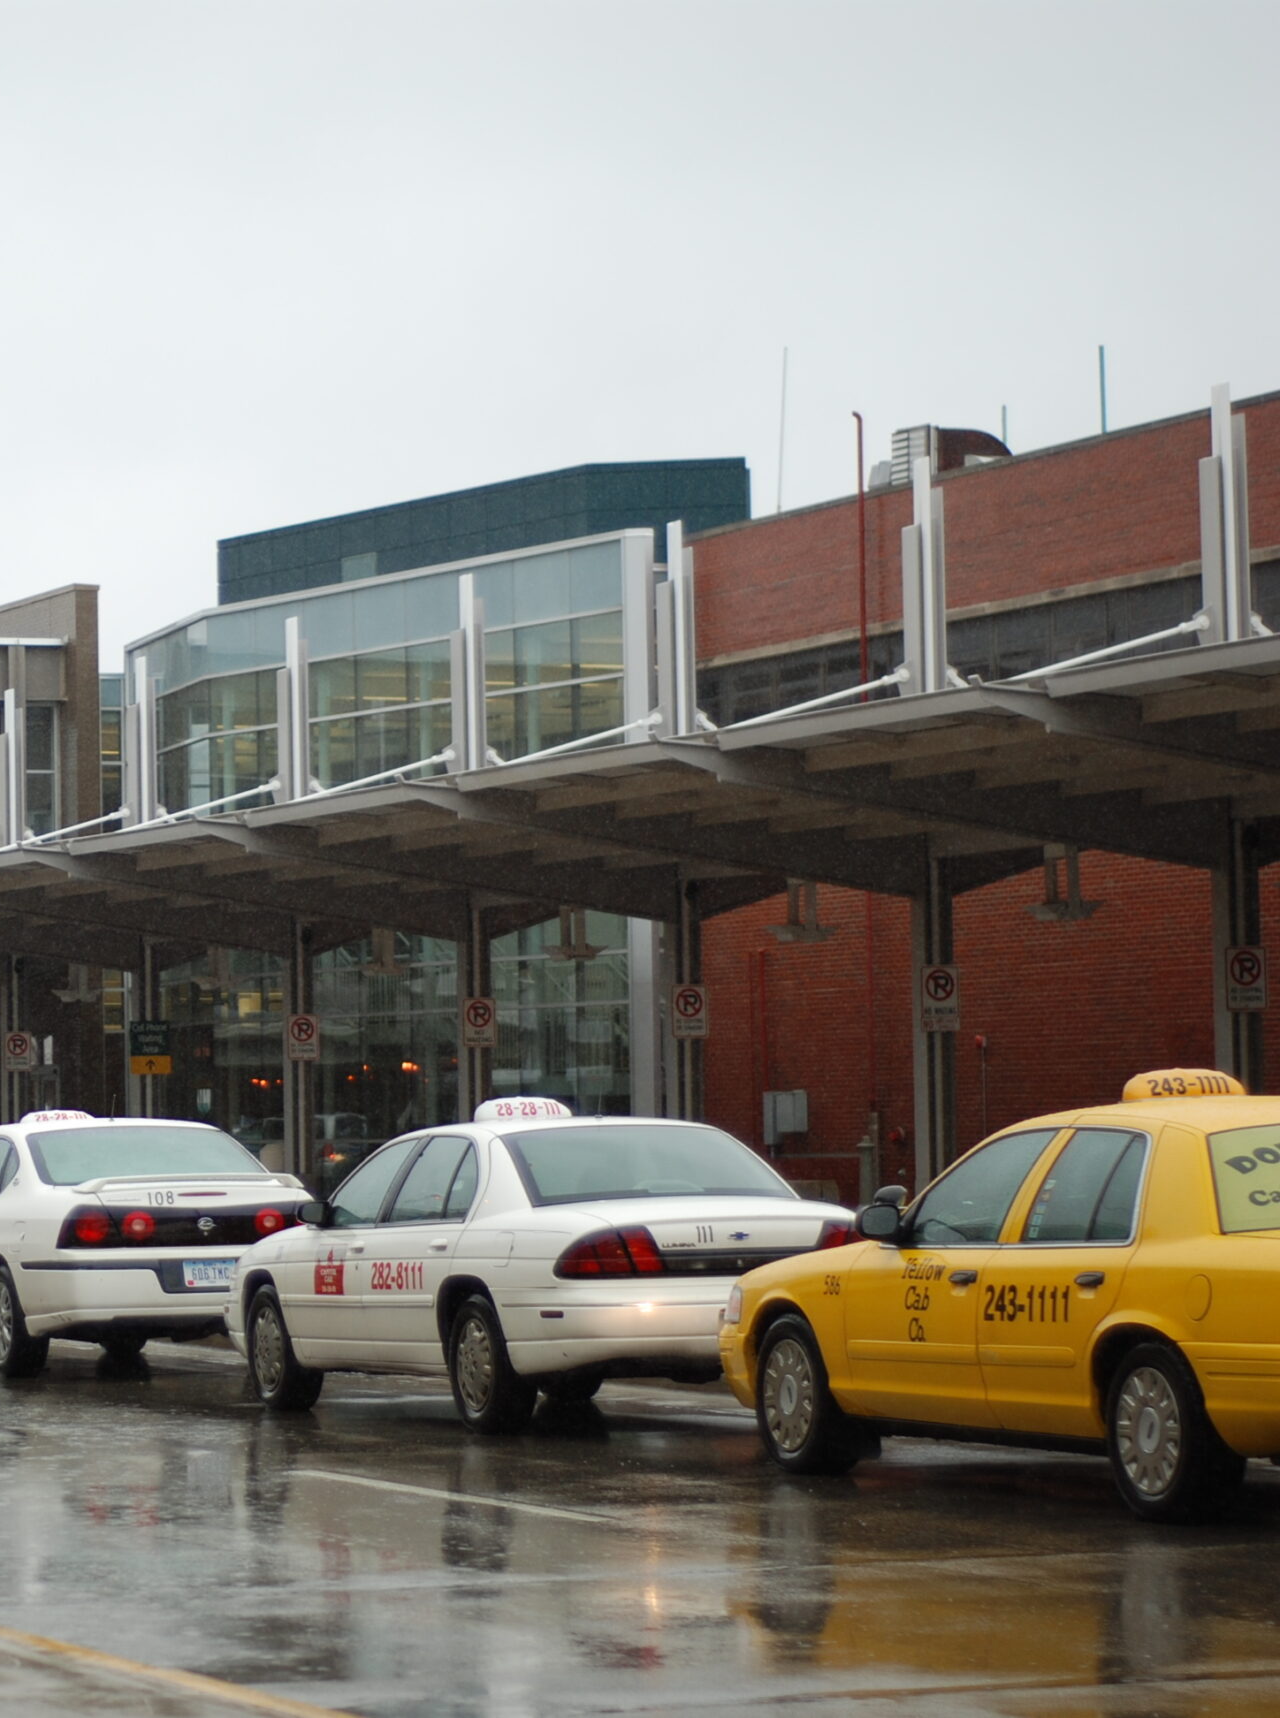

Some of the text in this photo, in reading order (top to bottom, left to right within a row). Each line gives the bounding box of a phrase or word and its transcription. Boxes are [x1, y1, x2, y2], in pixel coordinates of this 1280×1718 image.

[1148, 1076, 1231, 1097] 243-1111
[495, 1102, 561, 1117] 28-28-111
[1224, 1143, 1280, 1175] DO
[147, 1190, 175, 1206] 108
[696, 1224, 714, 1244] 111
[370, 1261, 424, 1291] 282-8111
[901, 1257, 946, 1281] Yellow
[904, 1285, 930, 1311] Cab
[984, 1284, 1071, 1323] 243-1111
